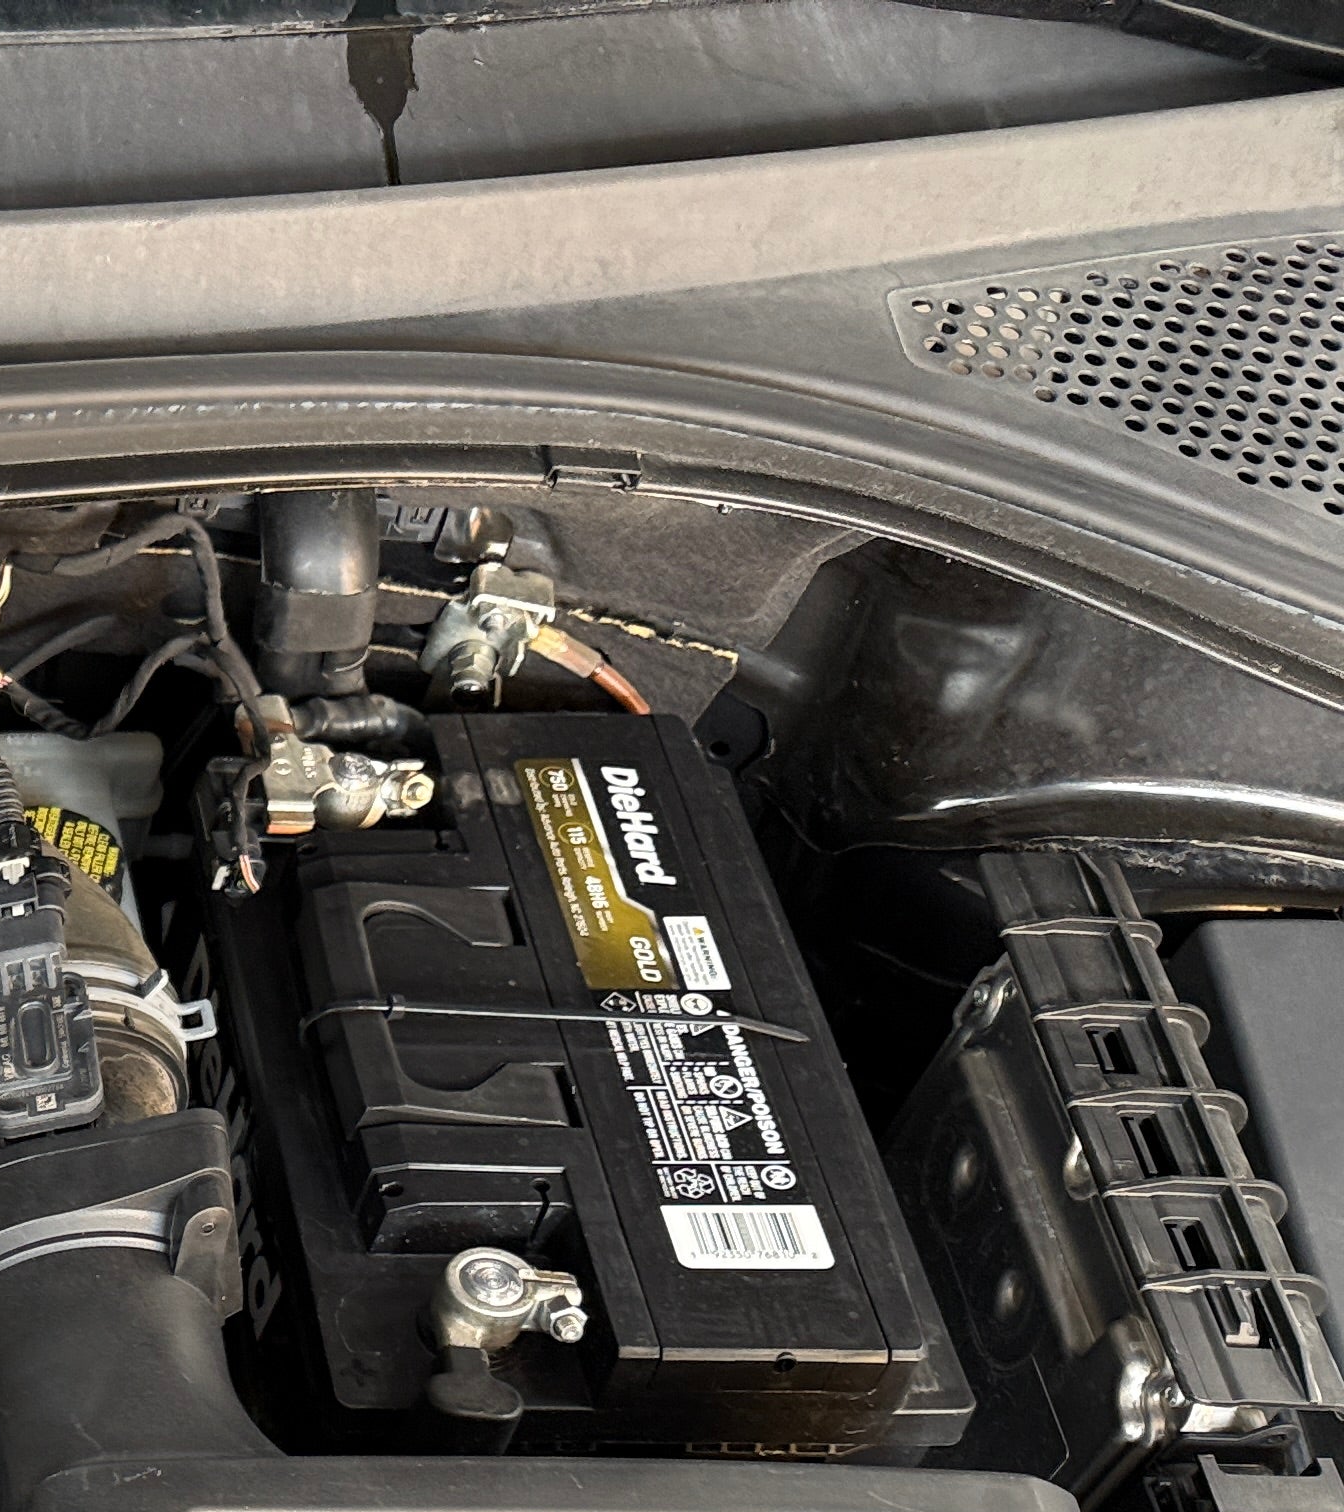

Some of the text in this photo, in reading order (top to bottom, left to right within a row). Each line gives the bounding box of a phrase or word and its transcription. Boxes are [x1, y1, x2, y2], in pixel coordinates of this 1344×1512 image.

[546, 770, 570, 791] 750
[565, 826, 588, 844] 115
[598, 766, 679, 884] DieHard
[582, 876, 610, 908] 48H6
[627, 936, 663, 982] GOLD
[720, 1024, 786, 1154] DANGER/POISON
